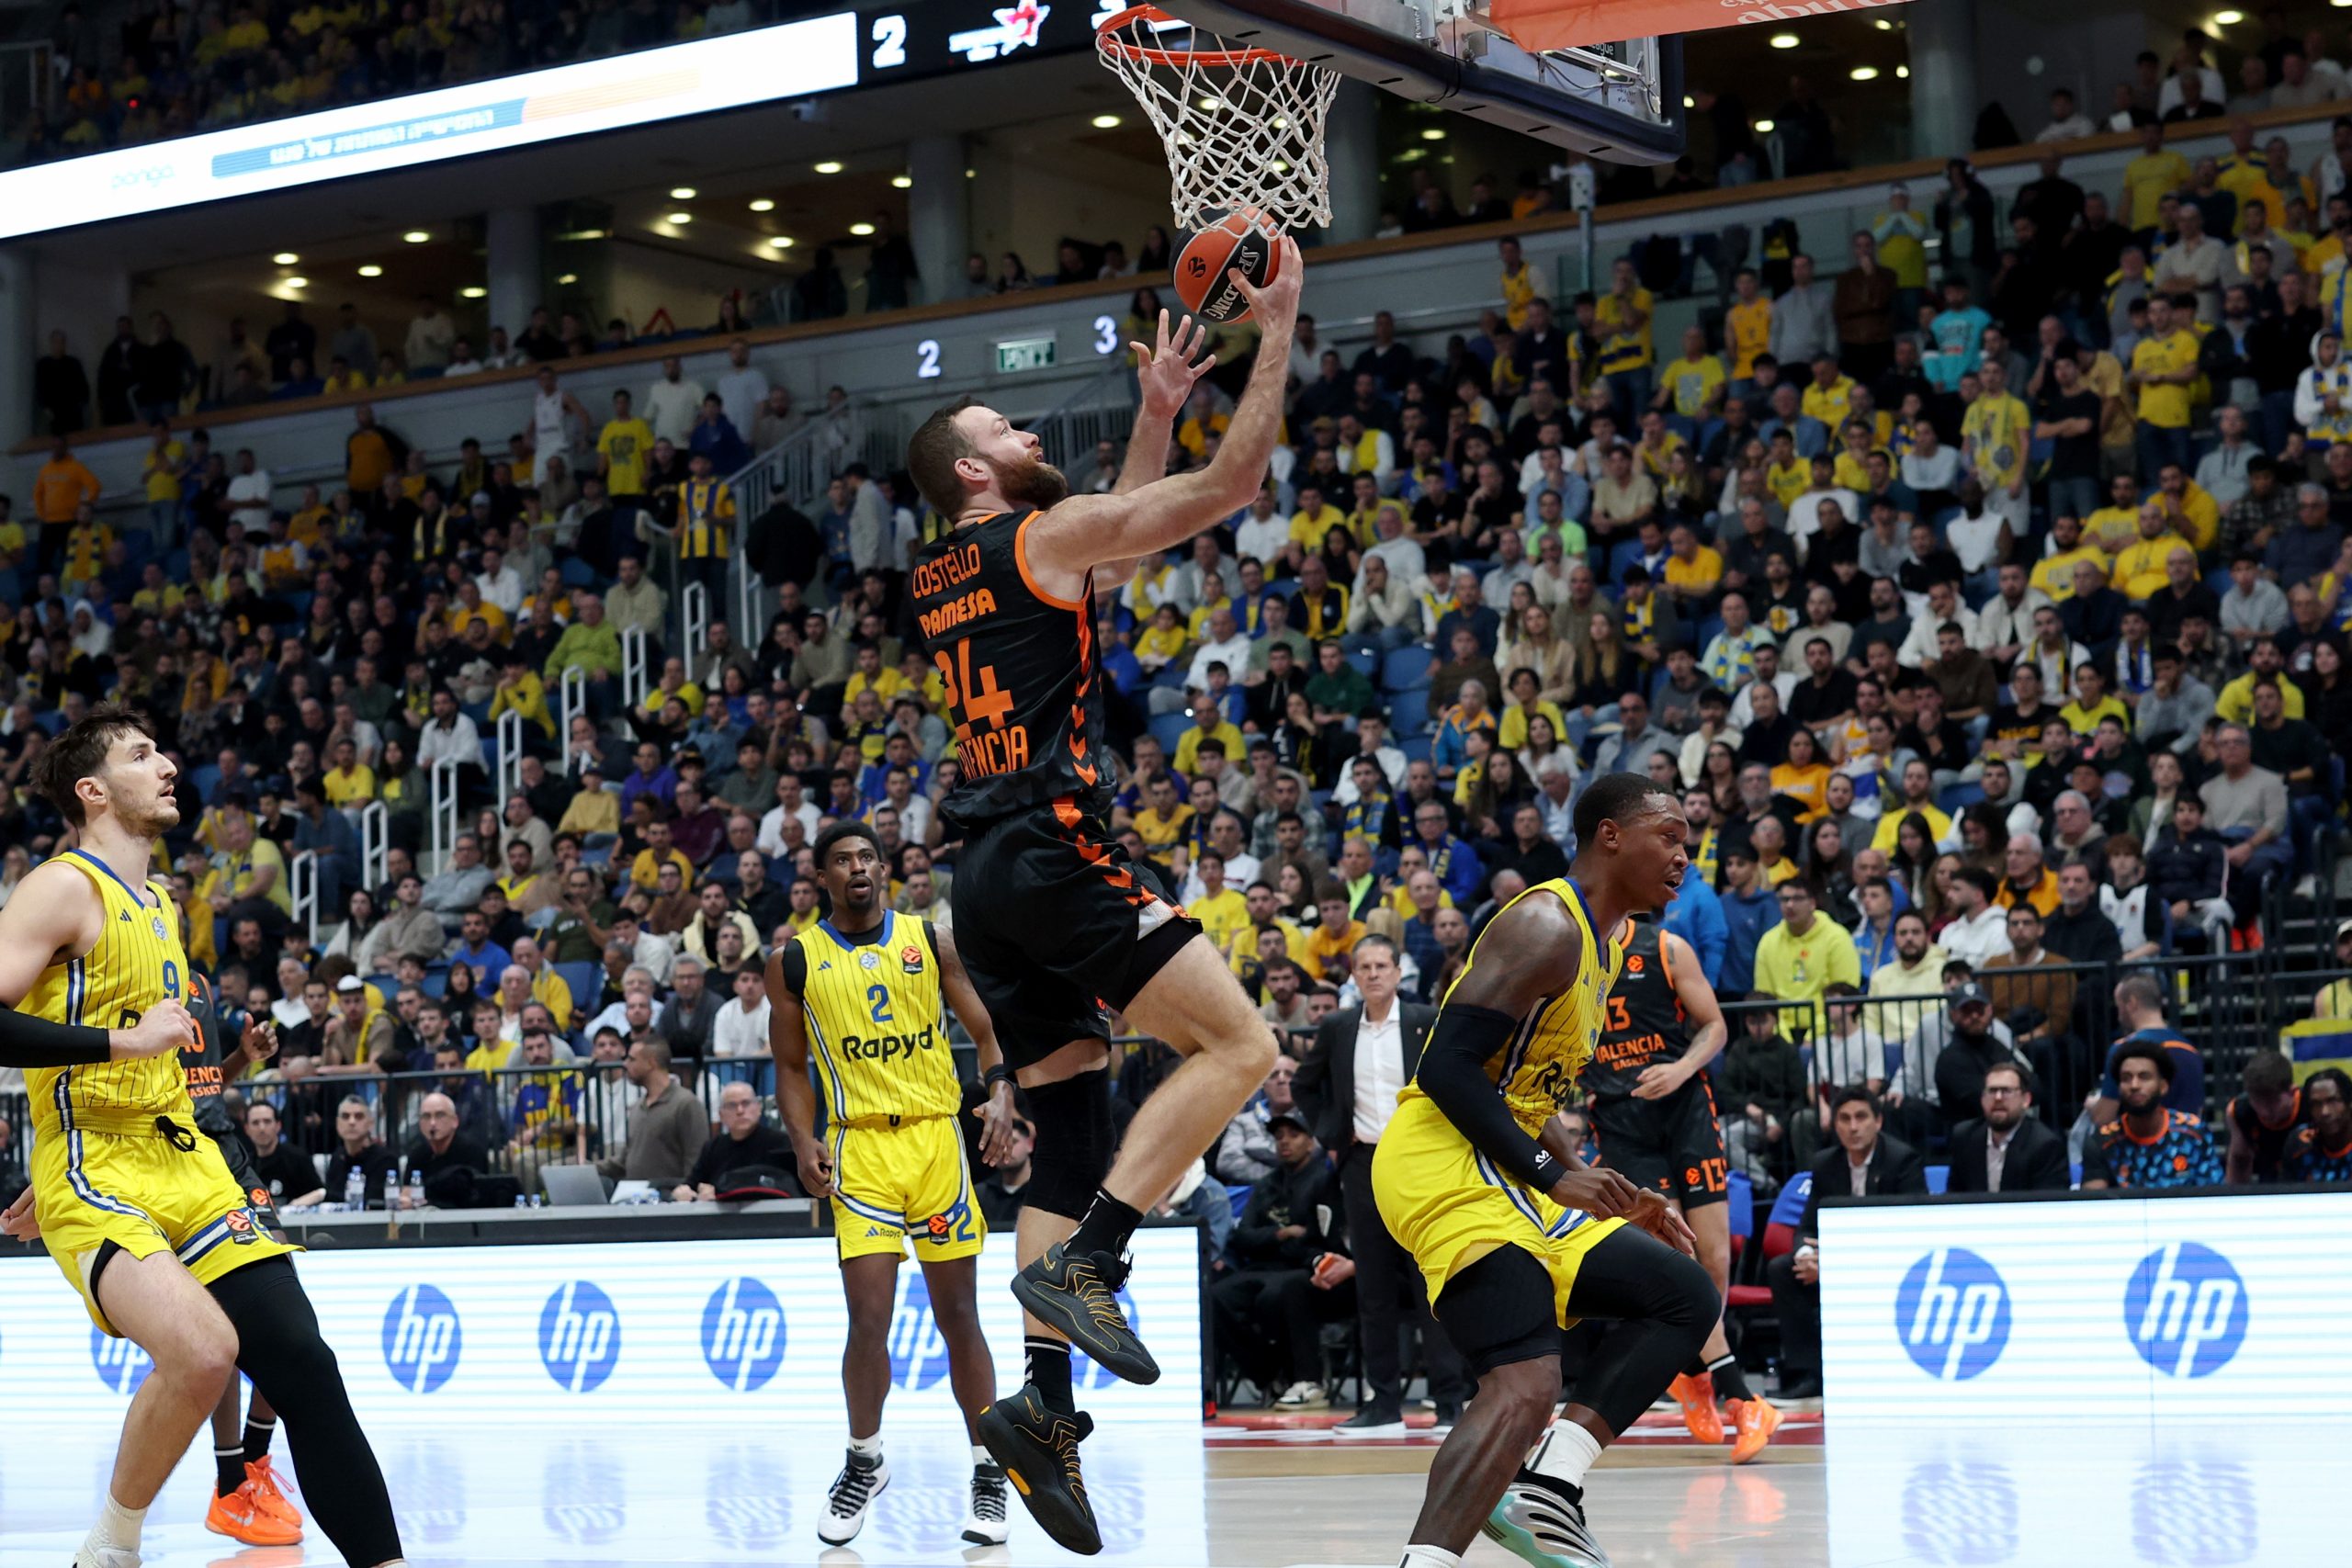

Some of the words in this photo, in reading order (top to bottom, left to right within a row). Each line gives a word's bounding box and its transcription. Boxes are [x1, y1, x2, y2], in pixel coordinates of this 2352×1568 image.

[872, 15, 907, 69] 2
[1204, 245, 1261, 321] SPDING
[917, 339, 942, 378] 2
[1093, 315, 1118, 355] 3
[912, 543, 981, 600] COSTELLO
[919, 588, 997, 640] PAMESA
[163, 960, 180, 999] 9
[866, 984, 893, 1023] 2
[842, 1023, 933, 1064] Rapyd
[187, 1084, 221, 1099] ASKET
[1700, 1157, 1727, 1193] 13
[956, 1201, 977, 1242] 2
[710, 1277, 781, 1391] hp
[1908, 1247, 2003, 1380] hp
[2140, 1242, 2237, 1378] hp
[390, 1284, 458, 1393] hp
[547, 1280, 616, 1393] hp
